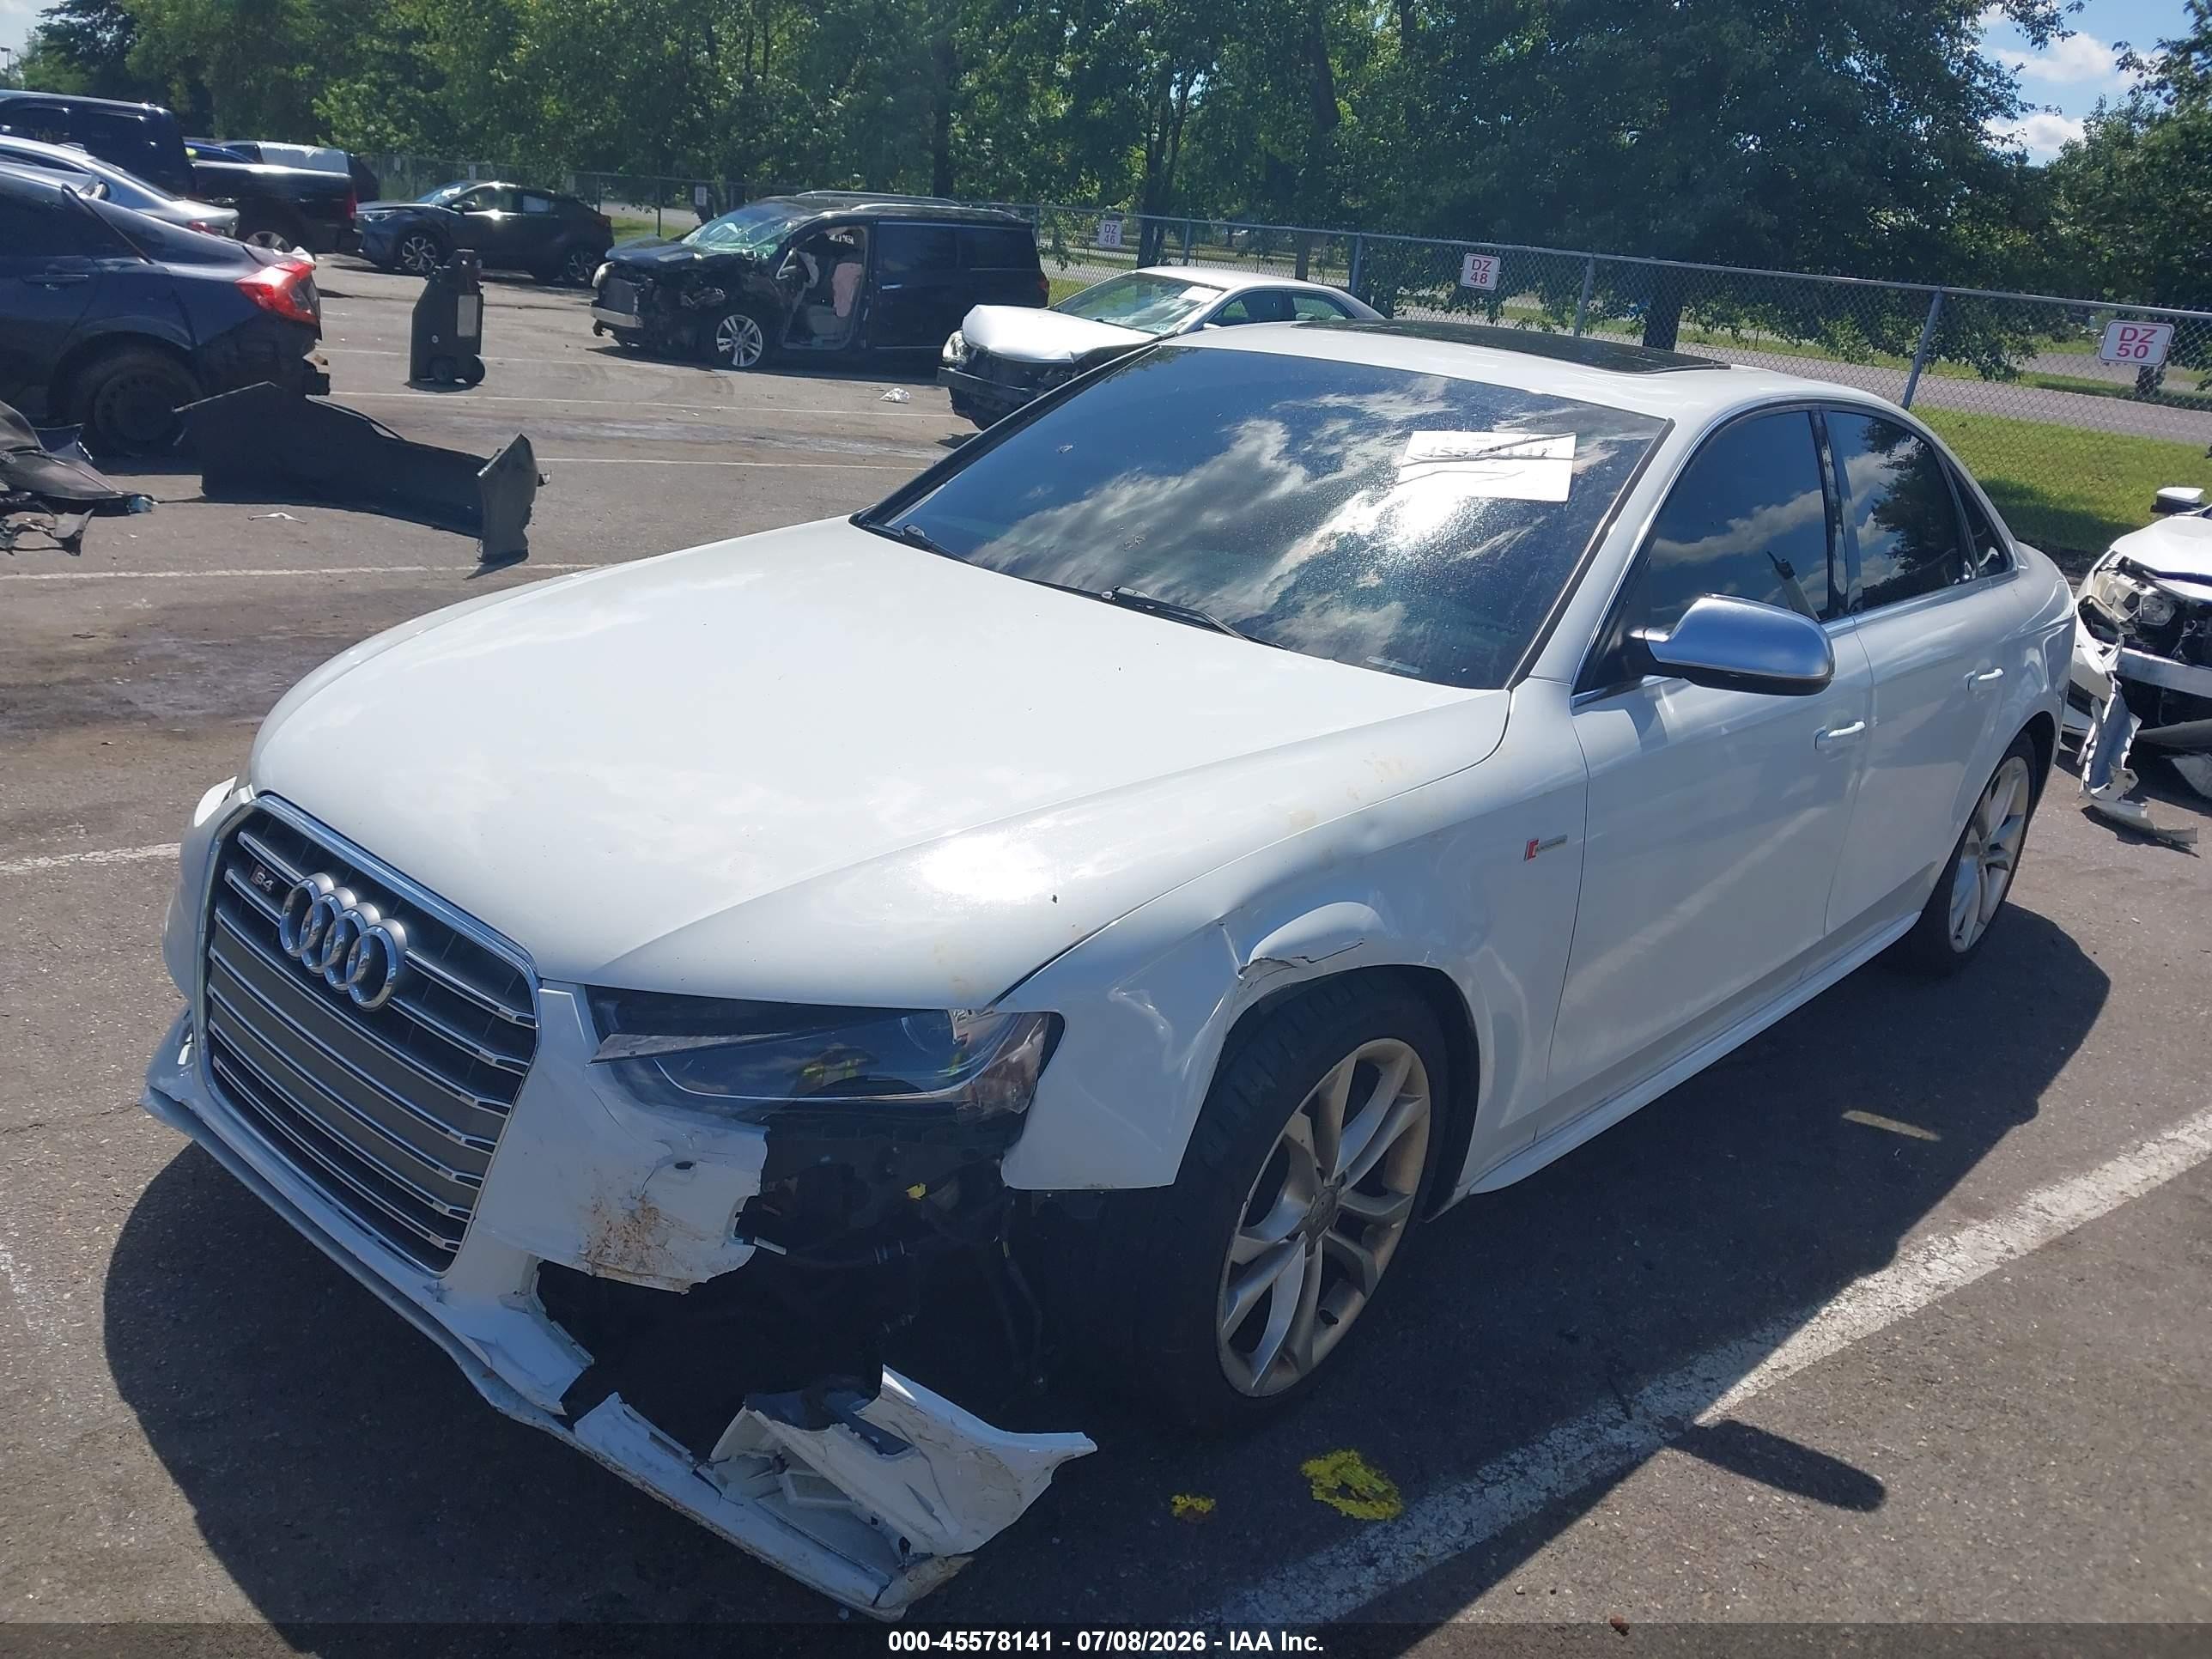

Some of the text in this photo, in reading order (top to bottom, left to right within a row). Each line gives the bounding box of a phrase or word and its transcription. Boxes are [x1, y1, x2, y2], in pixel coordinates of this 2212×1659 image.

[1104, 223, 1117, 234] DZ
[1104, 234, 1115, 244] 46
[1472, 258, 1492, 272] DZ
[1470, 271, 1488, 284] 48
[2119, 326, 2157, 343] DZ
[2116, 343, 2149, 359] 50
[255, 872, 274, 892] S4
